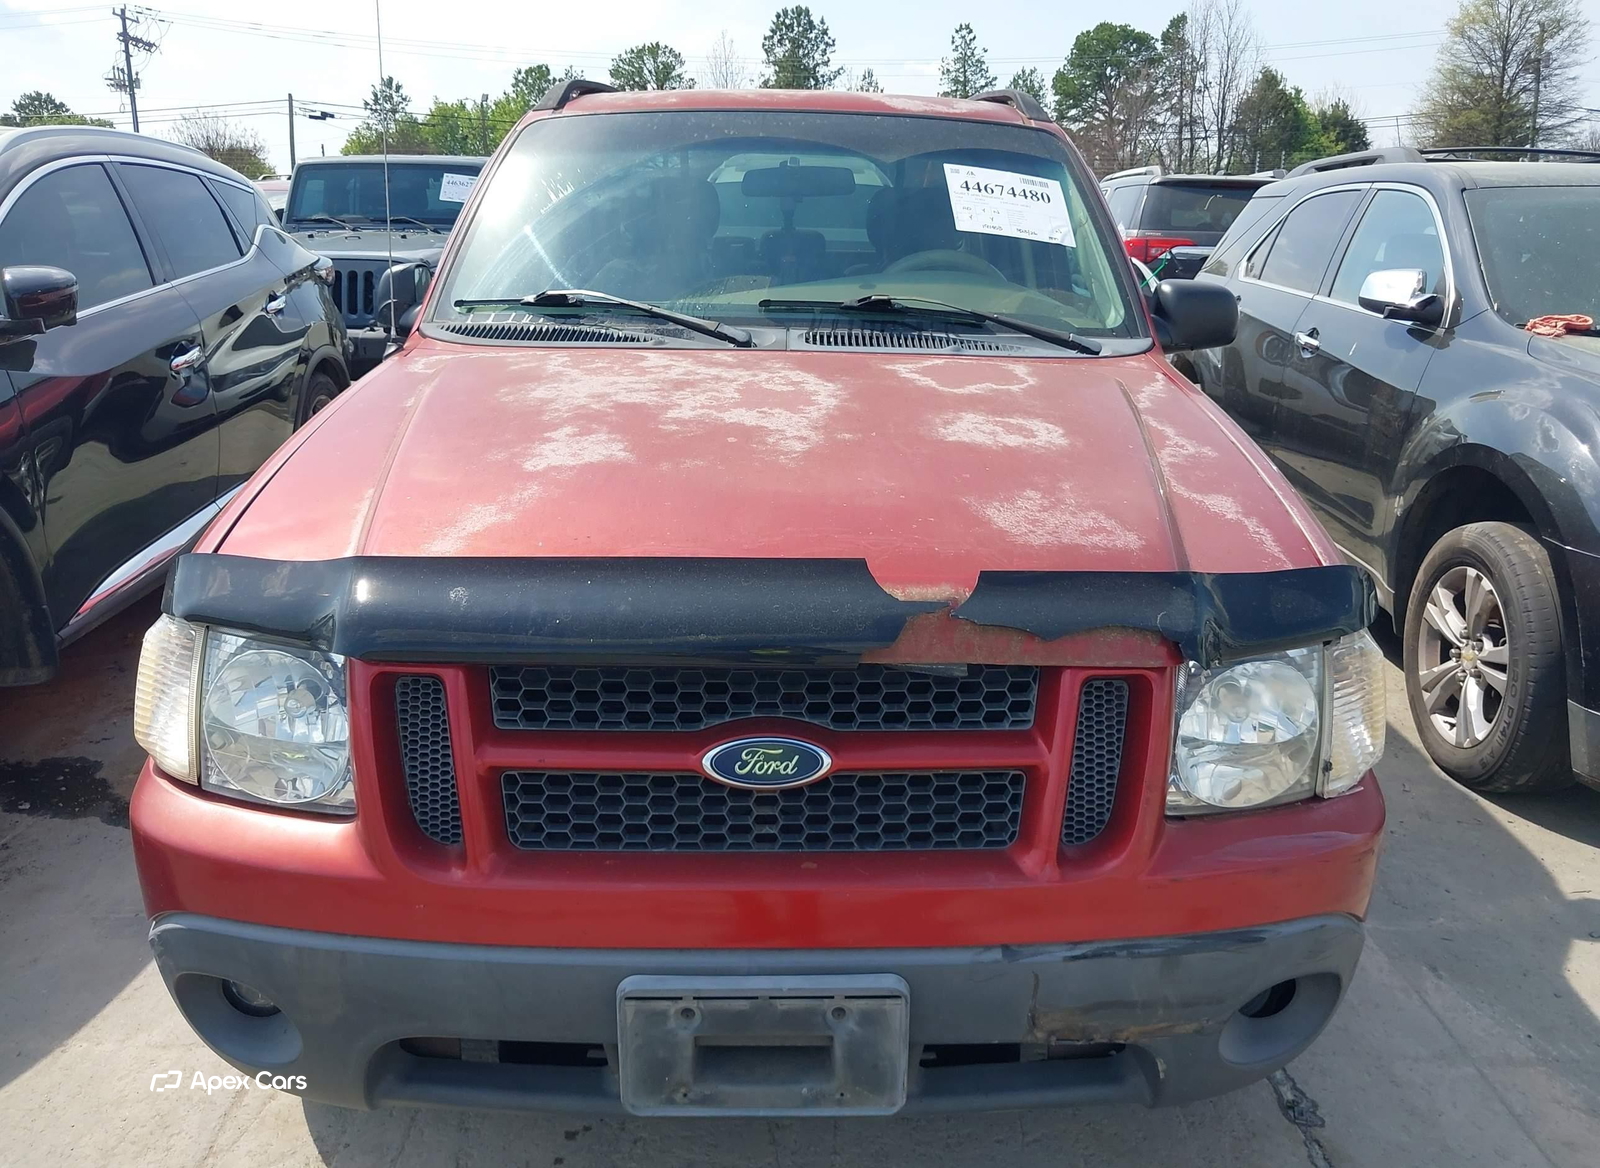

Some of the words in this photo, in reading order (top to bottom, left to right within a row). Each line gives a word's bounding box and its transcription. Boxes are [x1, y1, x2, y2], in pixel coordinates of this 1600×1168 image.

[447, 180, 475, 188] 4463627
[960, 180, 1051, 204] 44674480
[735, 748, 800, 775] Ford
